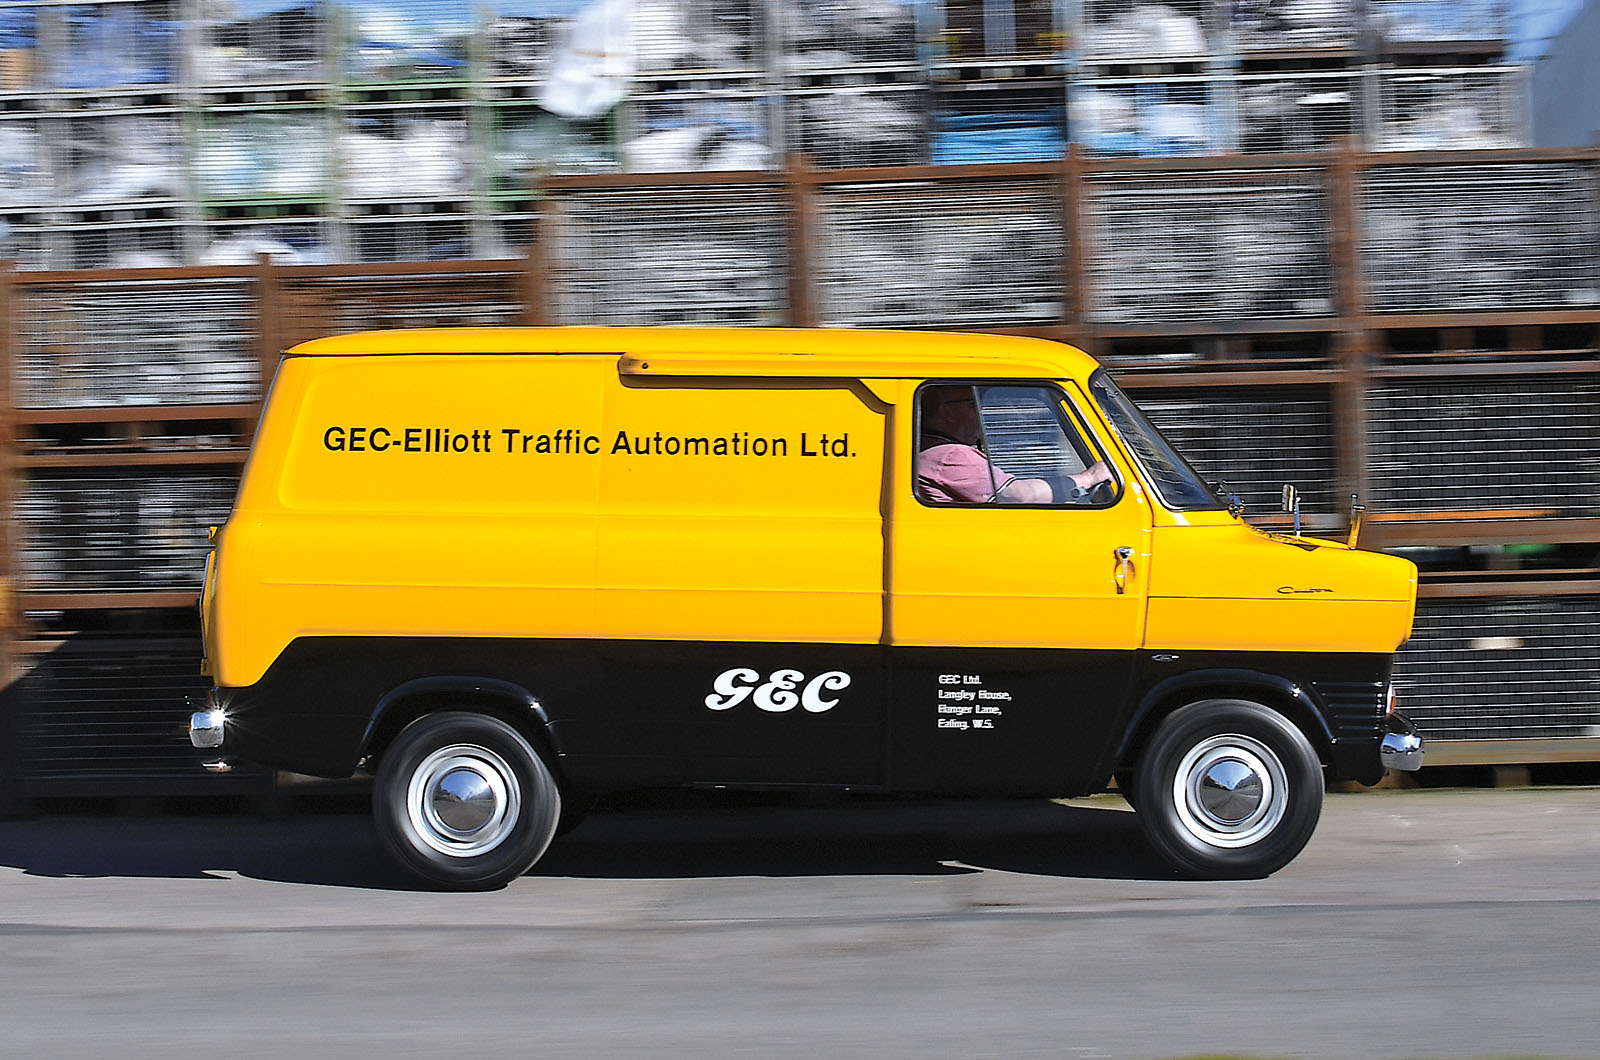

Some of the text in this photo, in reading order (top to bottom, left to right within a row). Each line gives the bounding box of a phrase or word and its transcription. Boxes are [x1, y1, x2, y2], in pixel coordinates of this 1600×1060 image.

[323, 426, 856, 458] GEC-Elliott Traffic Automation Ltd.
[704, 667, 852, 713] GEC
[938, 674, 983, 685] GEC Ltd.
[938, 689, 976, 702] Langley
